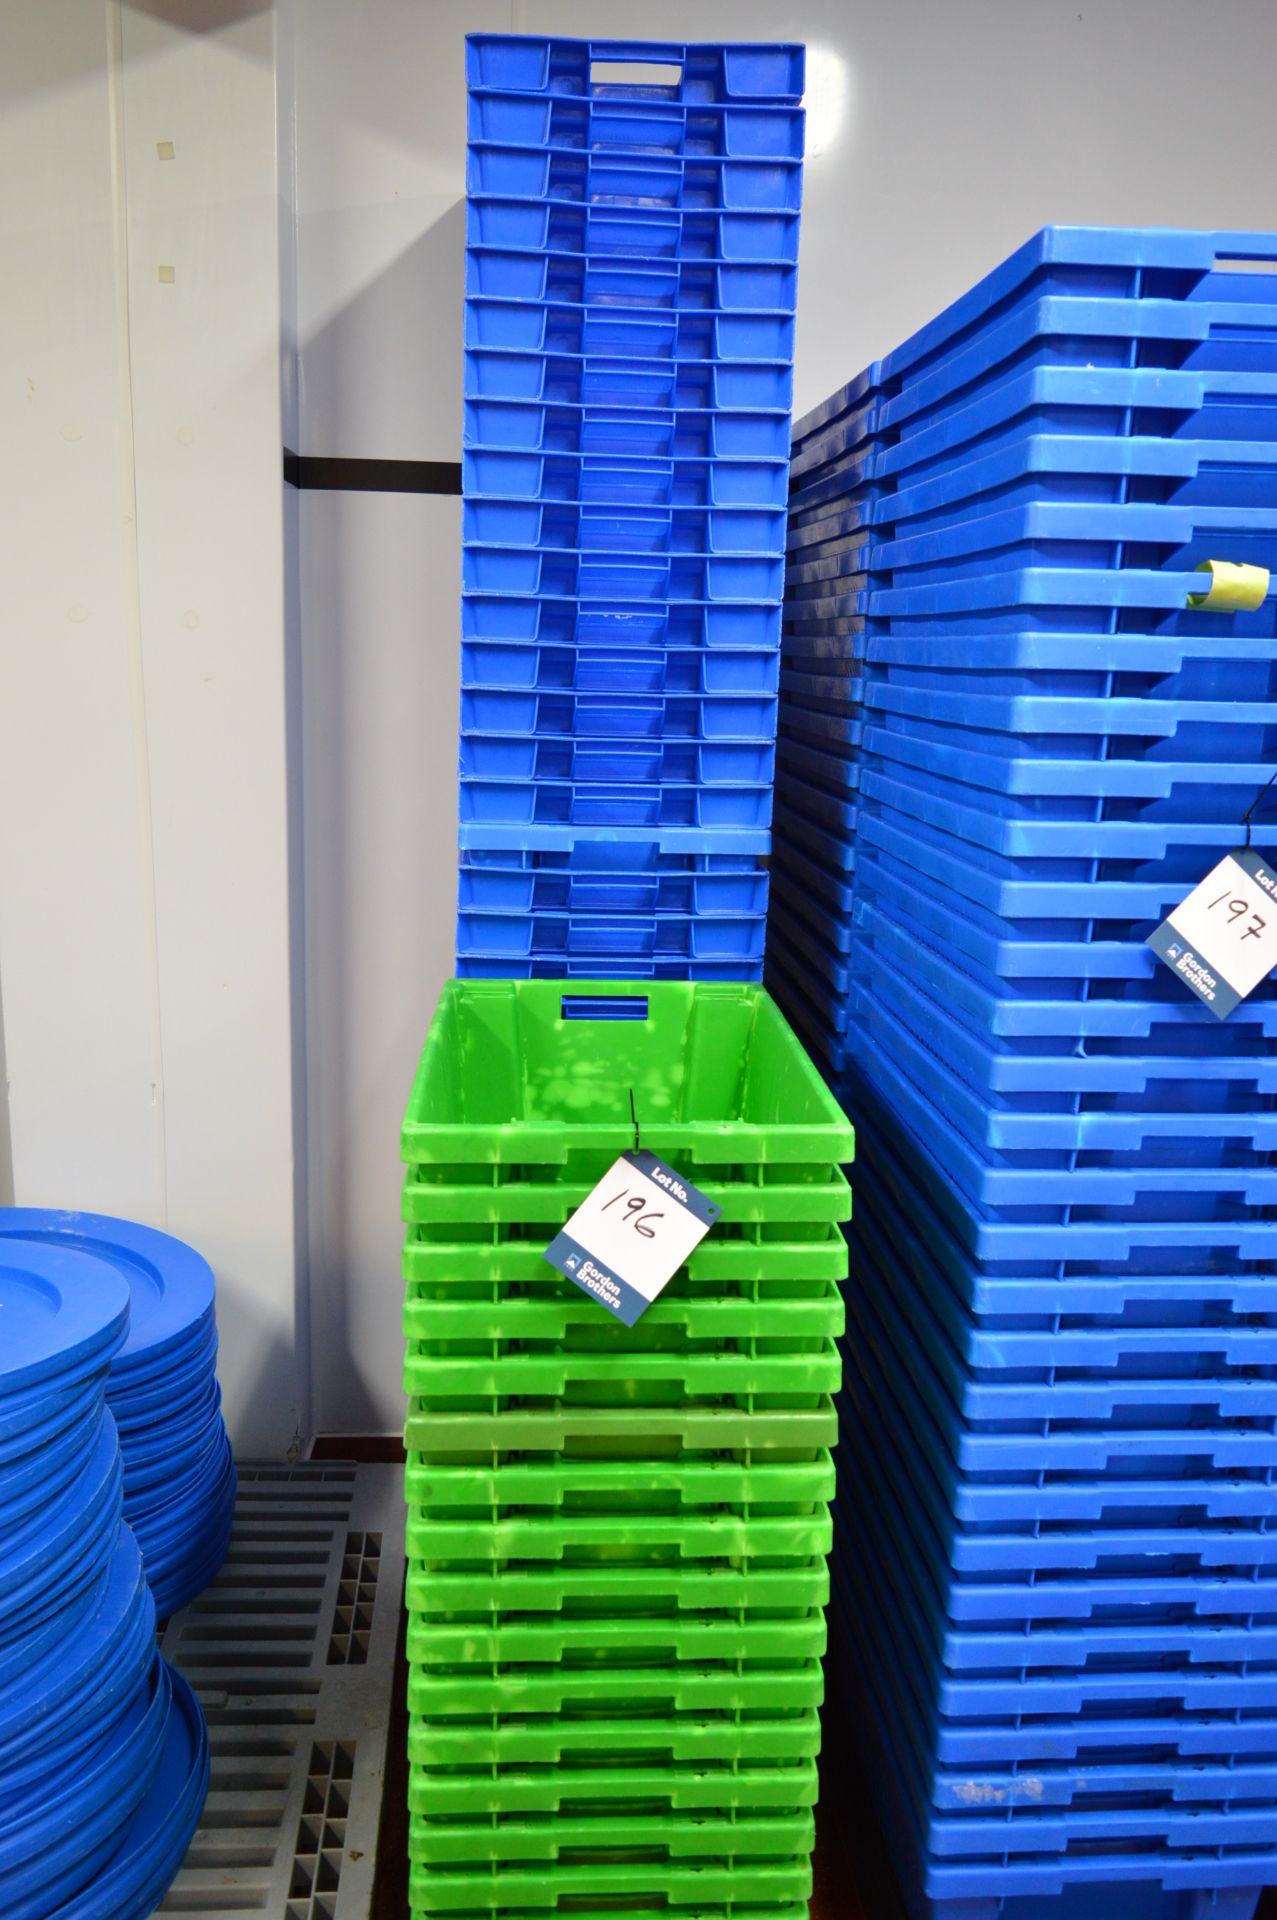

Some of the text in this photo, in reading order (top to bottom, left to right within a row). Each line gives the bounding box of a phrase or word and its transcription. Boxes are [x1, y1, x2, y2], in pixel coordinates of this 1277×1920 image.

[1254, 869, 1274, 890] Lot
[1207, 891, 1267, 940] 197
[1176, 959, 1216, 1001] Brothers
[1183, 952, 1217, 988] Gordon
[651, 1167, 688, 1203] Lot No.
[601, 1189, 664, 1239] 196
[576, 1269, 621, 1309] Brothers
[582, 1261, 621, 1296] Gordon
